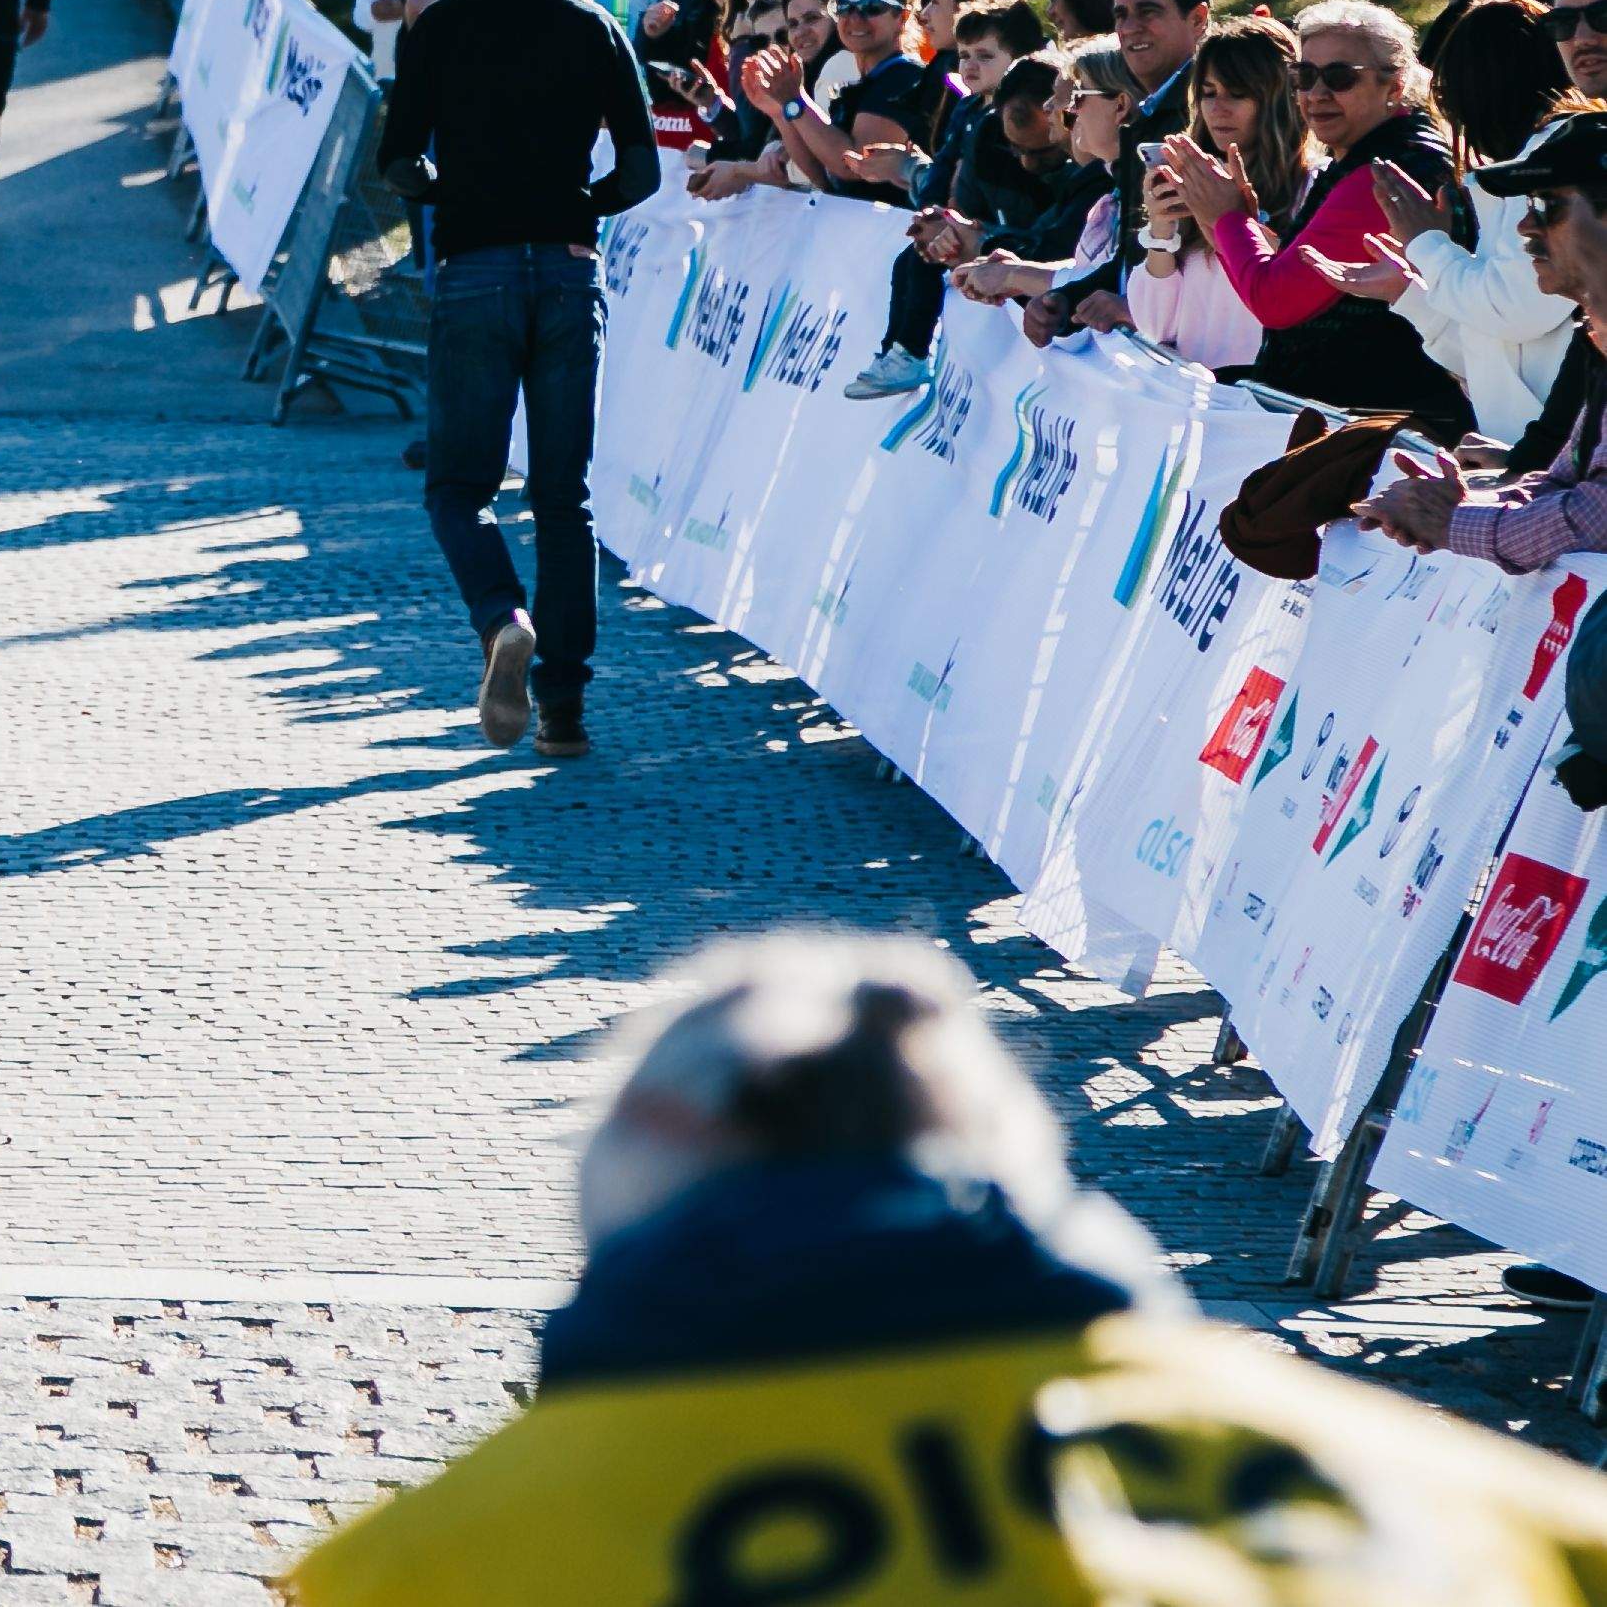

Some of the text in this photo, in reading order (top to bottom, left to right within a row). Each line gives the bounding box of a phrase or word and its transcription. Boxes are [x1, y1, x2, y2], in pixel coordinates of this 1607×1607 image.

[686, 265, 749, 368] MetLife
[765, 300, 848, 393] MetLife
[1151, 490, 1240, 653] MetLife
